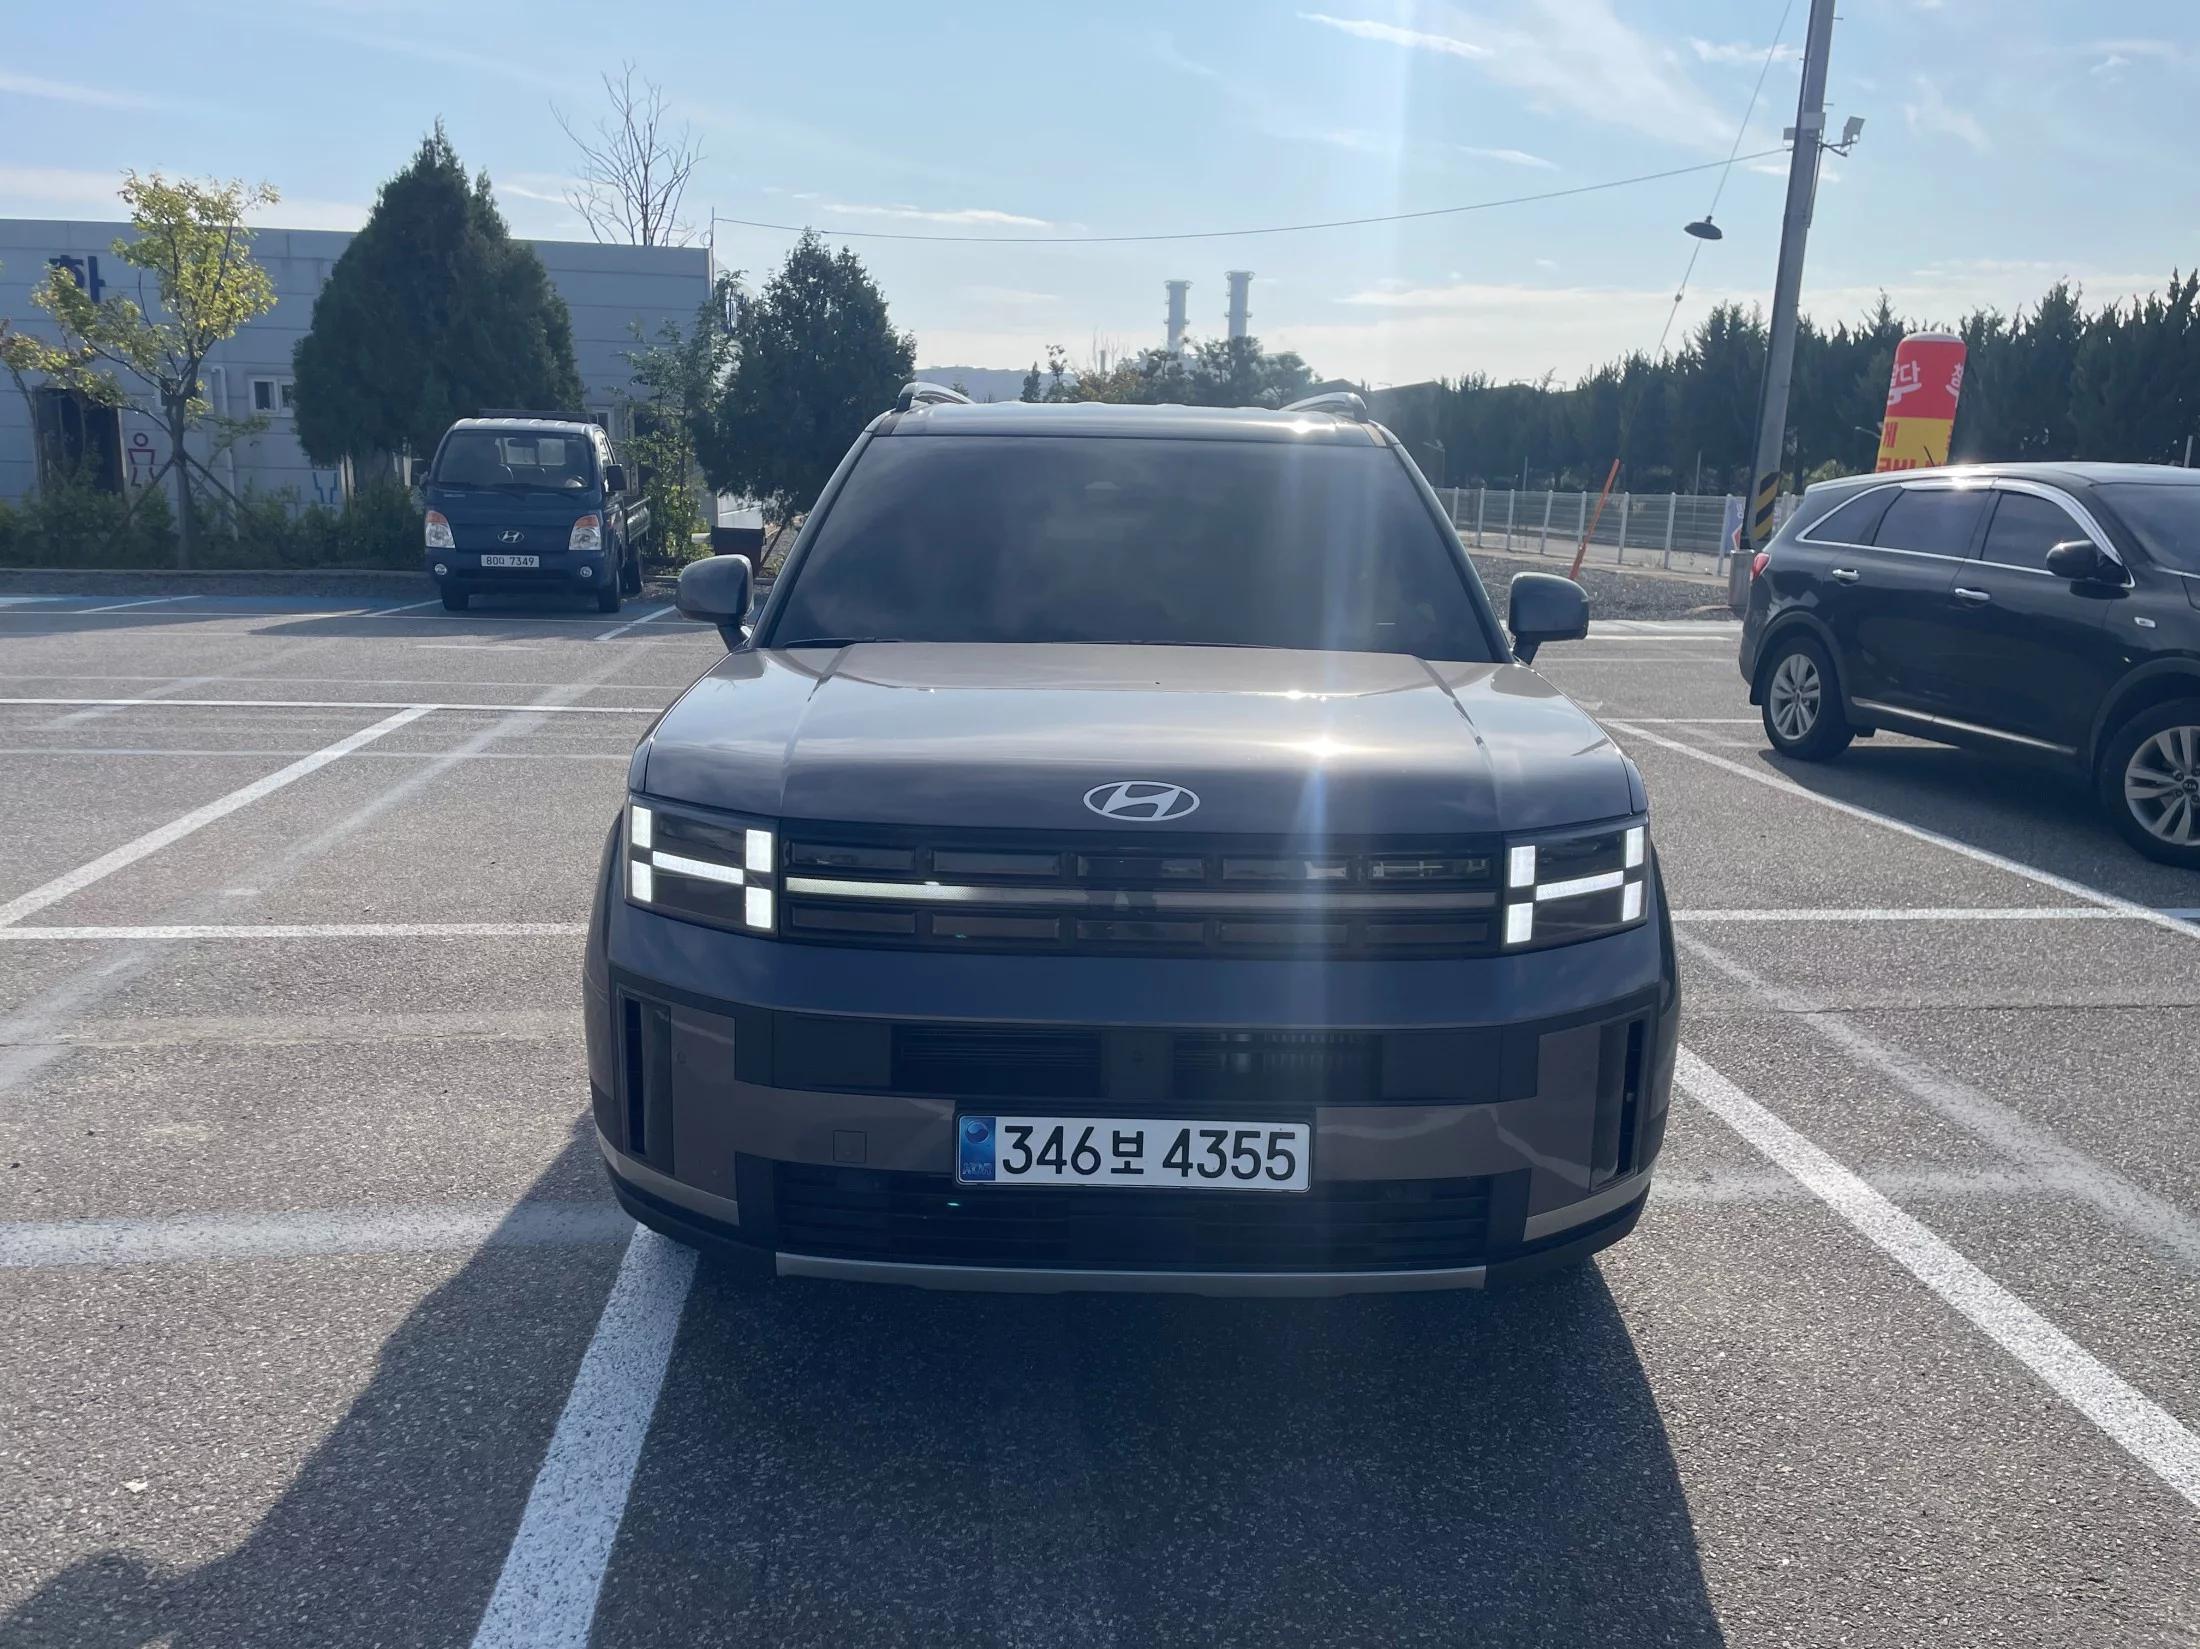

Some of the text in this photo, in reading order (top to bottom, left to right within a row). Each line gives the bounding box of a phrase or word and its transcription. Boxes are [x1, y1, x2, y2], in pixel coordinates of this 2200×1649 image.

[509, 556, 534, 567] 7349
[1002, 1125, 1297, 1181] 346보 4355
